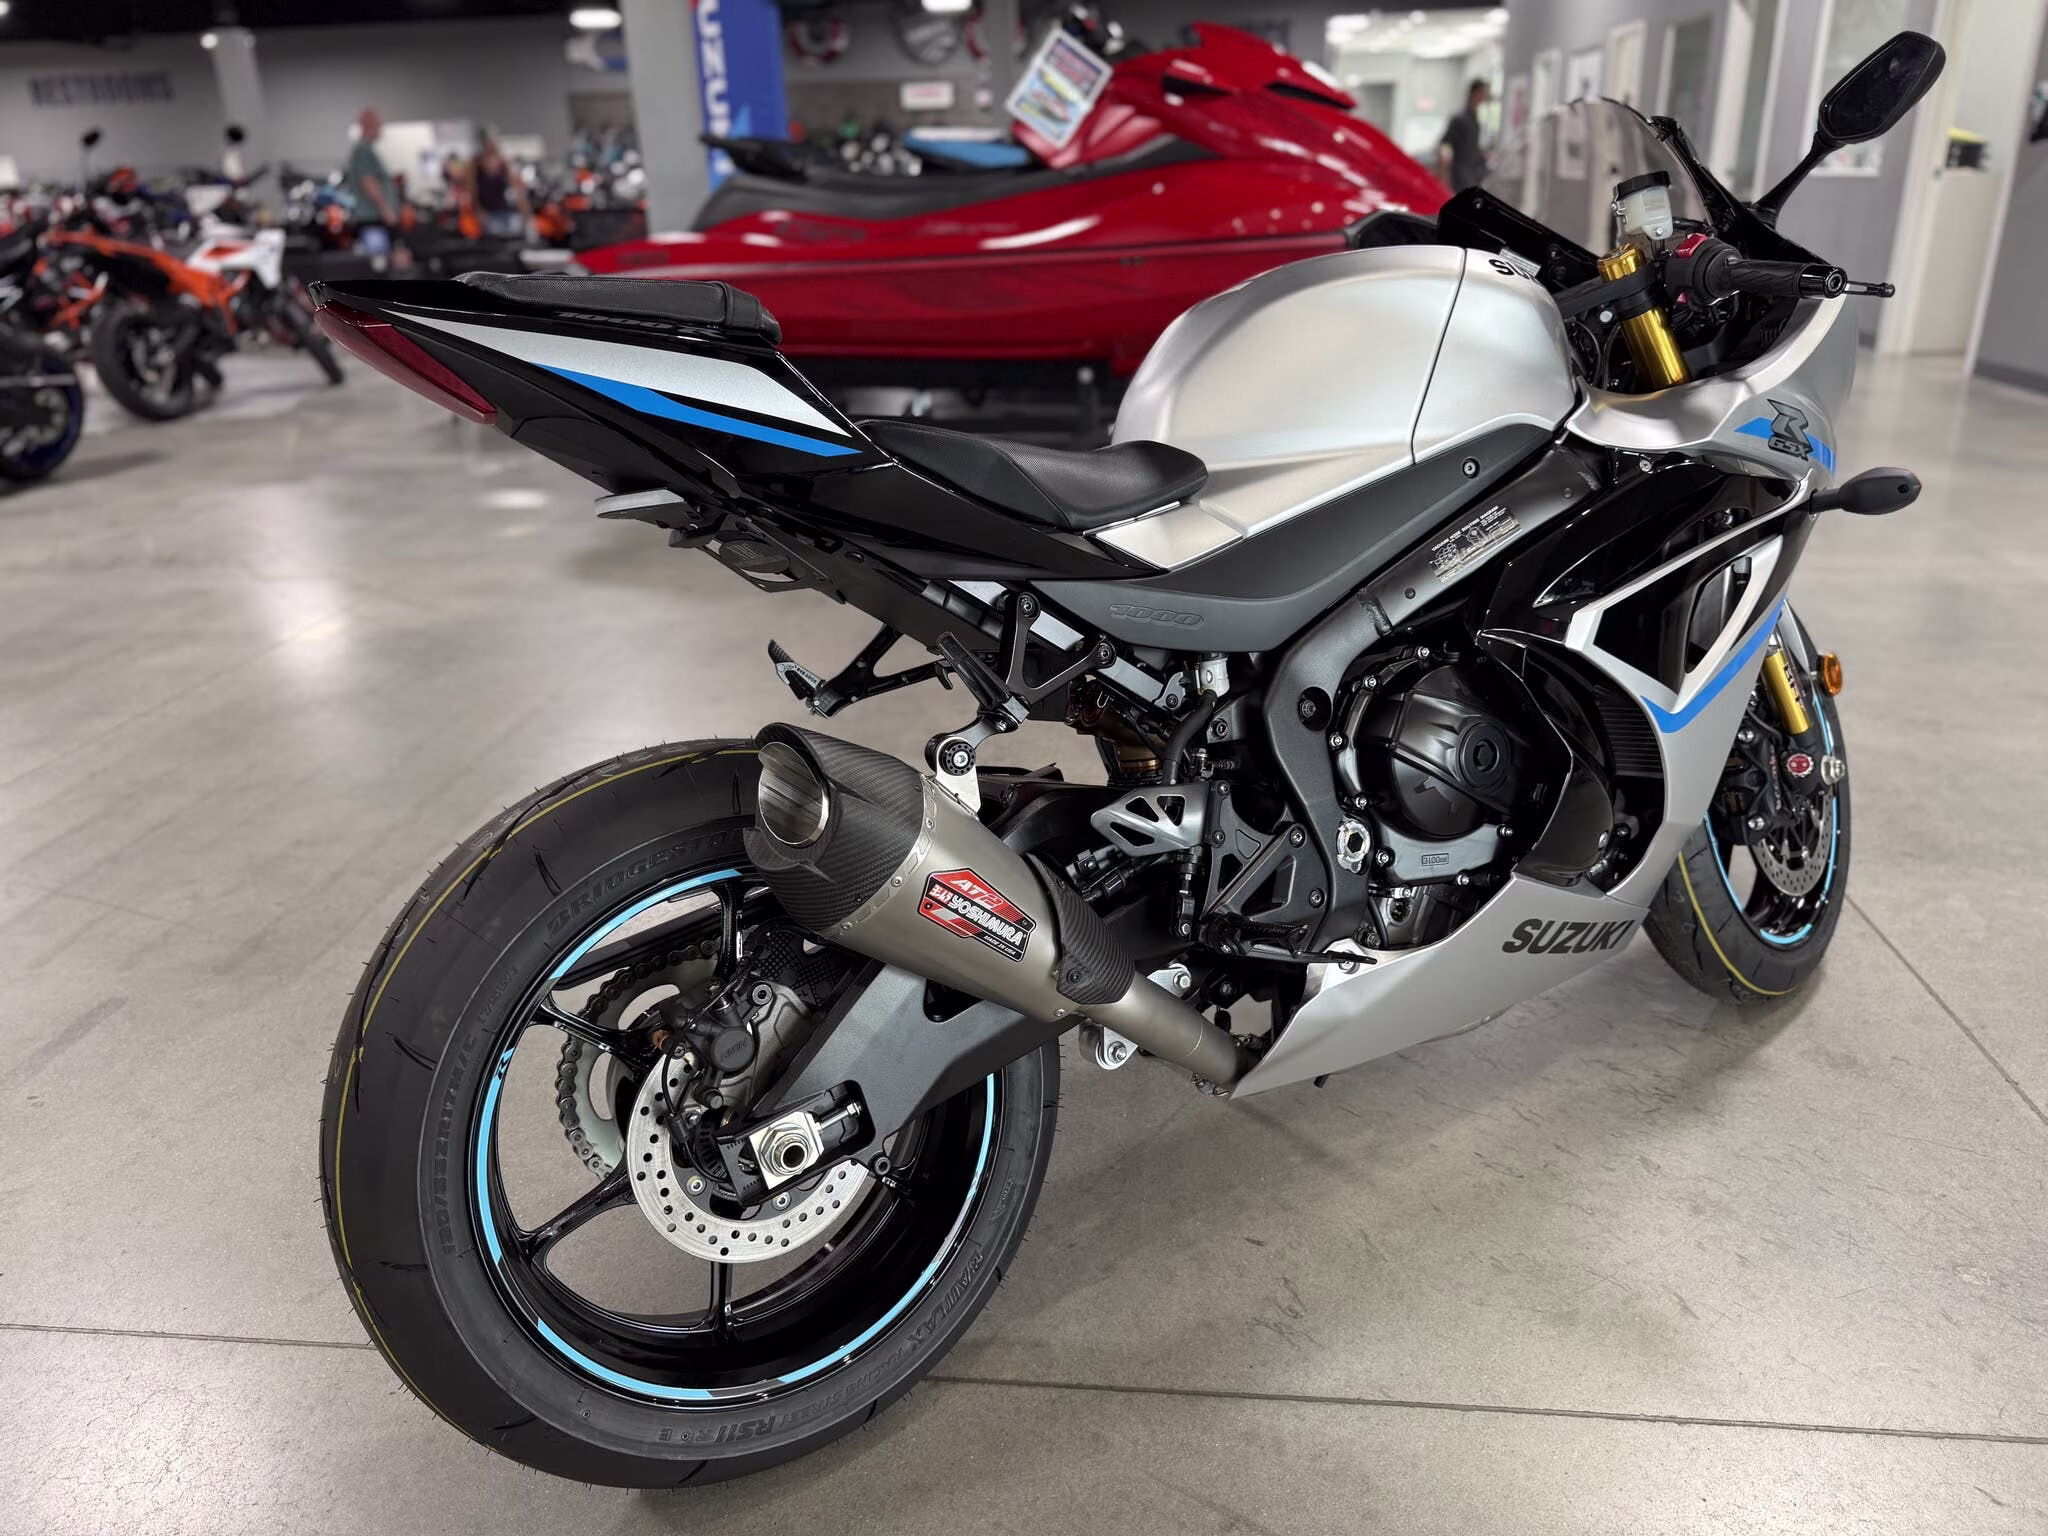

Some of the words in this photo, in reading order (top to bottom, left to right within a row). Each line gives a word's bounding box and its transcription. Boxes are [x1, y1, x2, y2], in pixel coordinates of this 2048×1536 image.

[950, 880, 1004, 910] AT2
[947, 894, 1024, 946] YOSHIMURA
[1501, 918, 1636, 954] SUZUKI
